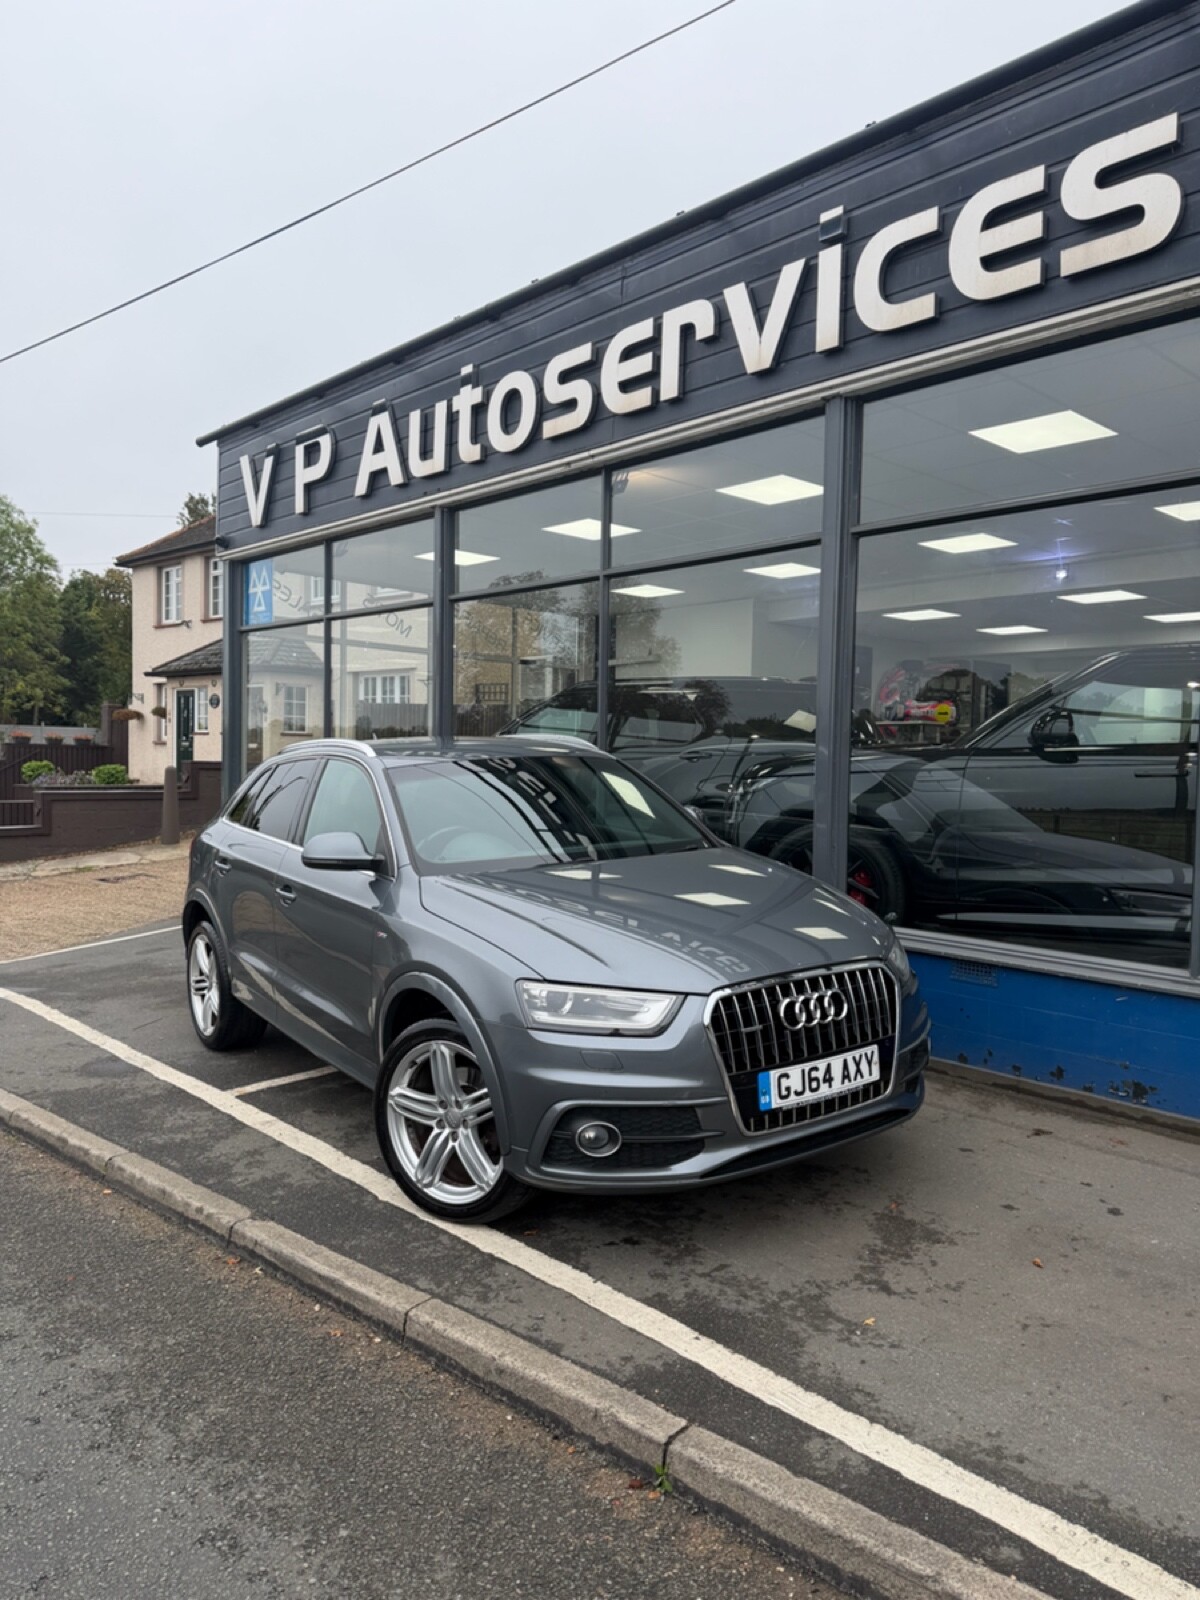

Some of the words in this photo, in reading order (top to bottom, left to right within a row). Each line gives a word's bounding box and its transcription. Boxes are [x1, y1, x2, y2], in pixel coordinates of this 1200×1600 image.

[239, 444, 279, 527] V
[294, 424, 336, 515] P
[354, 112, 1184, 497] Autoservices
[777, 1063, 834, 1100] GJ64
[841, 1050, 875, 1085] AXY
